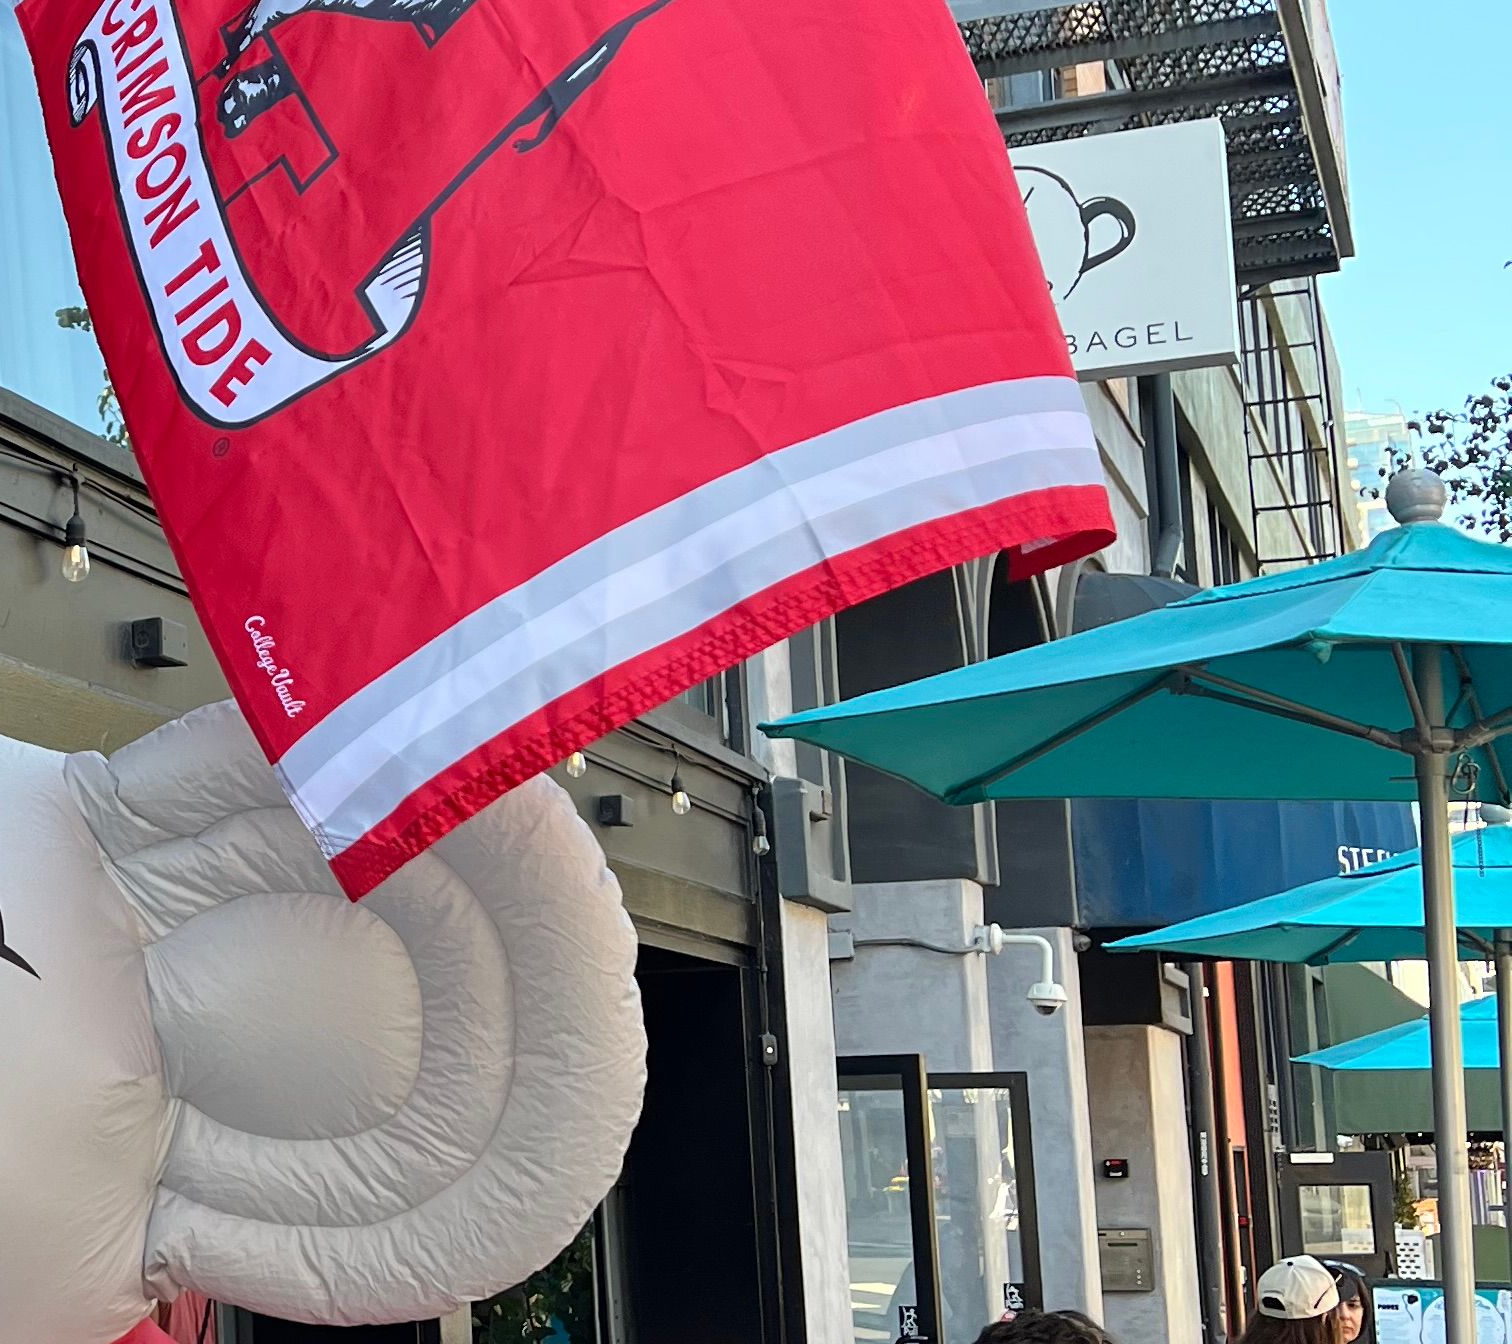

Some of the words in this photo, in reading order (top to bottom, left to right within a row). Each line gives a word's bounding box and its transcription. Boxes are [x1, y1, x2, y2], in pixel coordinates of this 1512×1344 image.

[164, 238, 273, 408] TIDE
[244, 615, 278, 676] College
[271, 668, 306, 718] Vault
